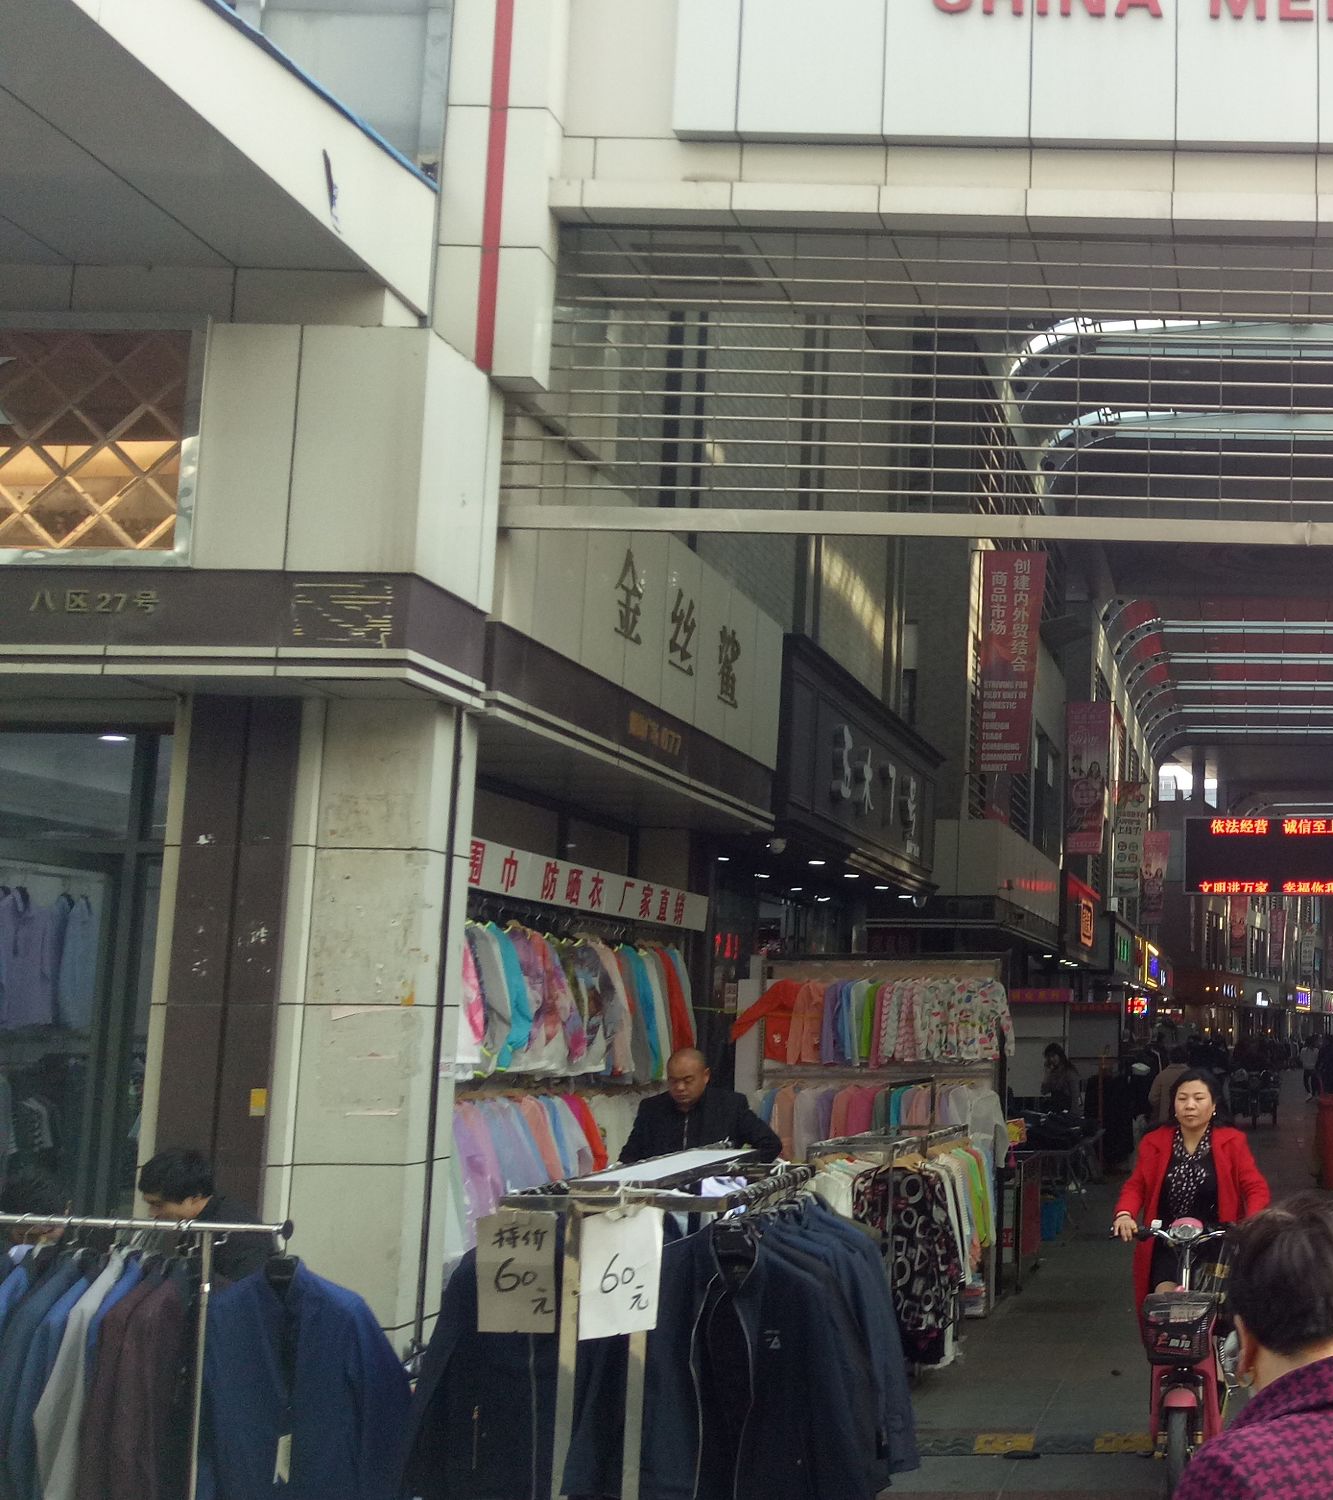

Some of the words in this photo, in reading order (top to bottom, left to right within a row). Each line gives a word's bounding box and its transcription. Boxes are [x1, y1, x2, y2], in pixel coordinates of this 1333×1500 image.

[29, 590, 160, 614] 八区27号
[989, 571, 1008, 636] 商品市场
[1010, 559, 1031, 672] 创建内外贸结合
[1210, 819, 1269, 834] 依法经营
[494, 1257, 537, 1294] 60
[601, 1253, 635, 1294] 60
[630, 1285, 649, 1311] 元
